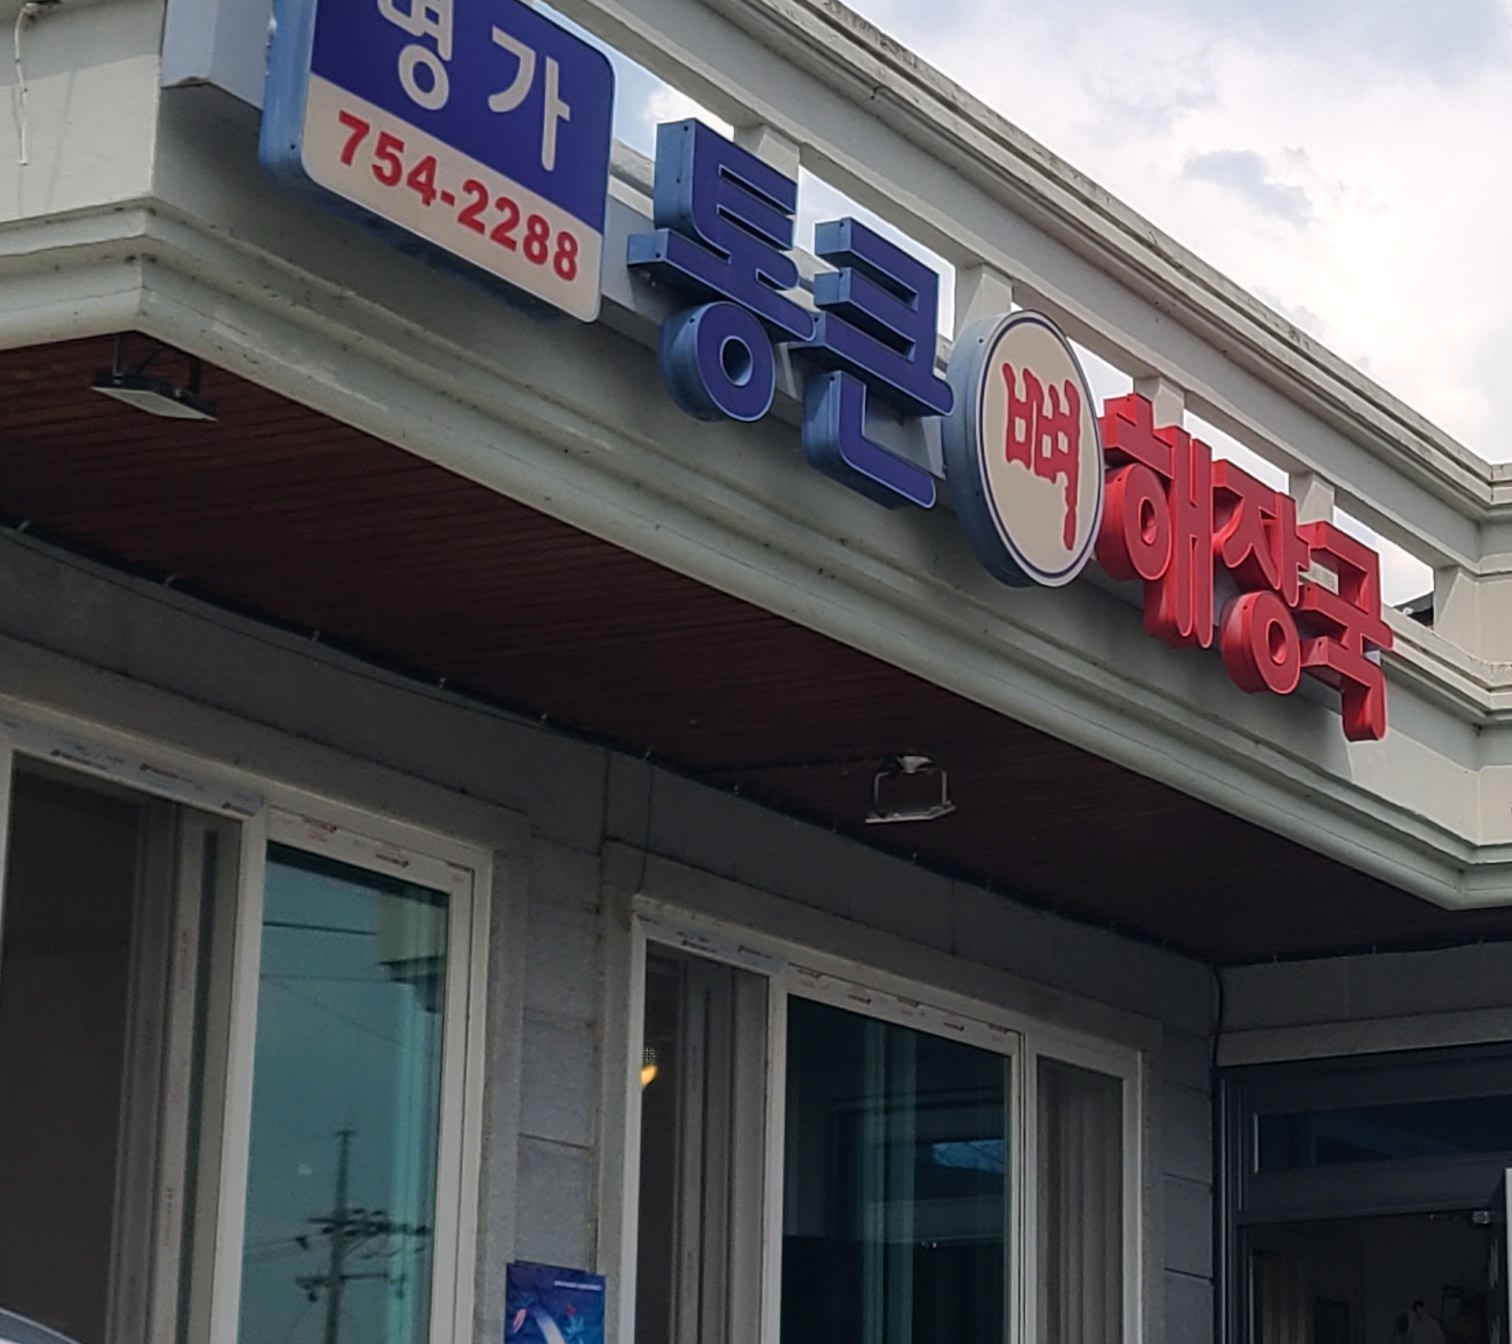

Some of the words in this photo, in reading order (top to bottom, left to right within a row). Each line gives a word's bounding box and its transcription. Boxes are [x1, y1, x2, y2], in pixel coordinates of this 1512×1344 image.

[337, 109, 579, 282] 754-2288
[628, 118, 955, 510] 통큰
[1095, 391, 1394, 742] 해장국
